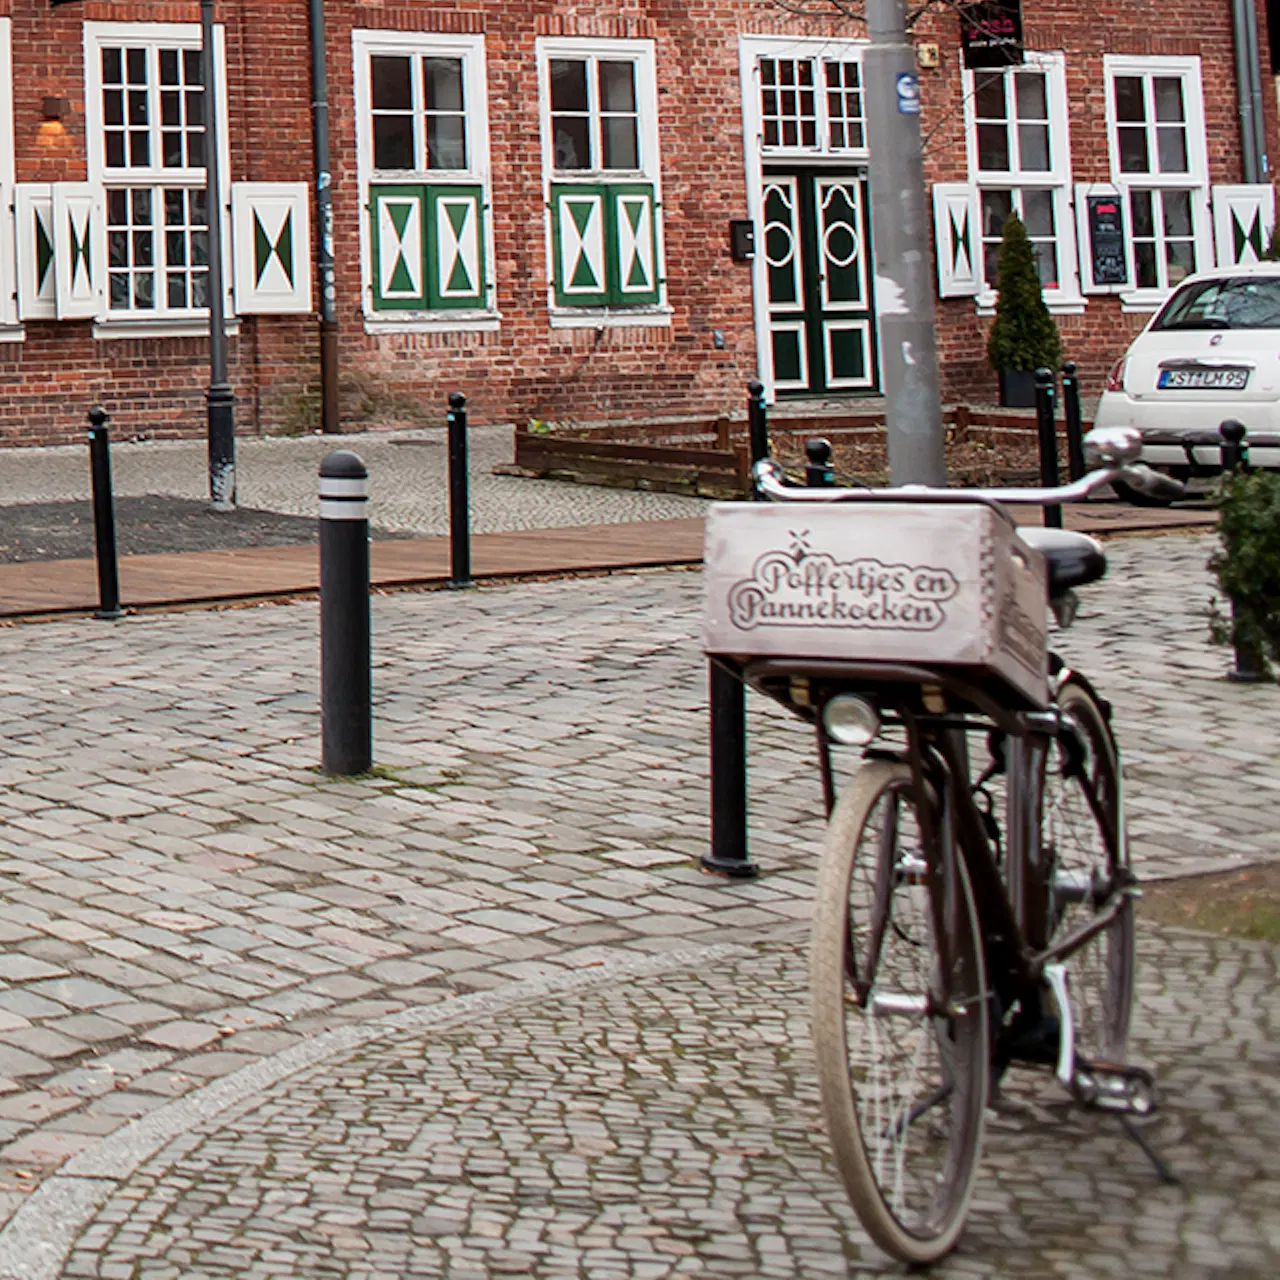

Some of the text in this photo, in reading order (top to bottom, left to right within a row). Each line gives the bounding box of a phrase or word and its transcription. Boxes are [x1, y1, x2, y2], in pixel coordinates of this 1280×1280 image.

[760, 560, 947, 598] Poffertjes en
[738, 588, 934, 622] Pannekoeken
